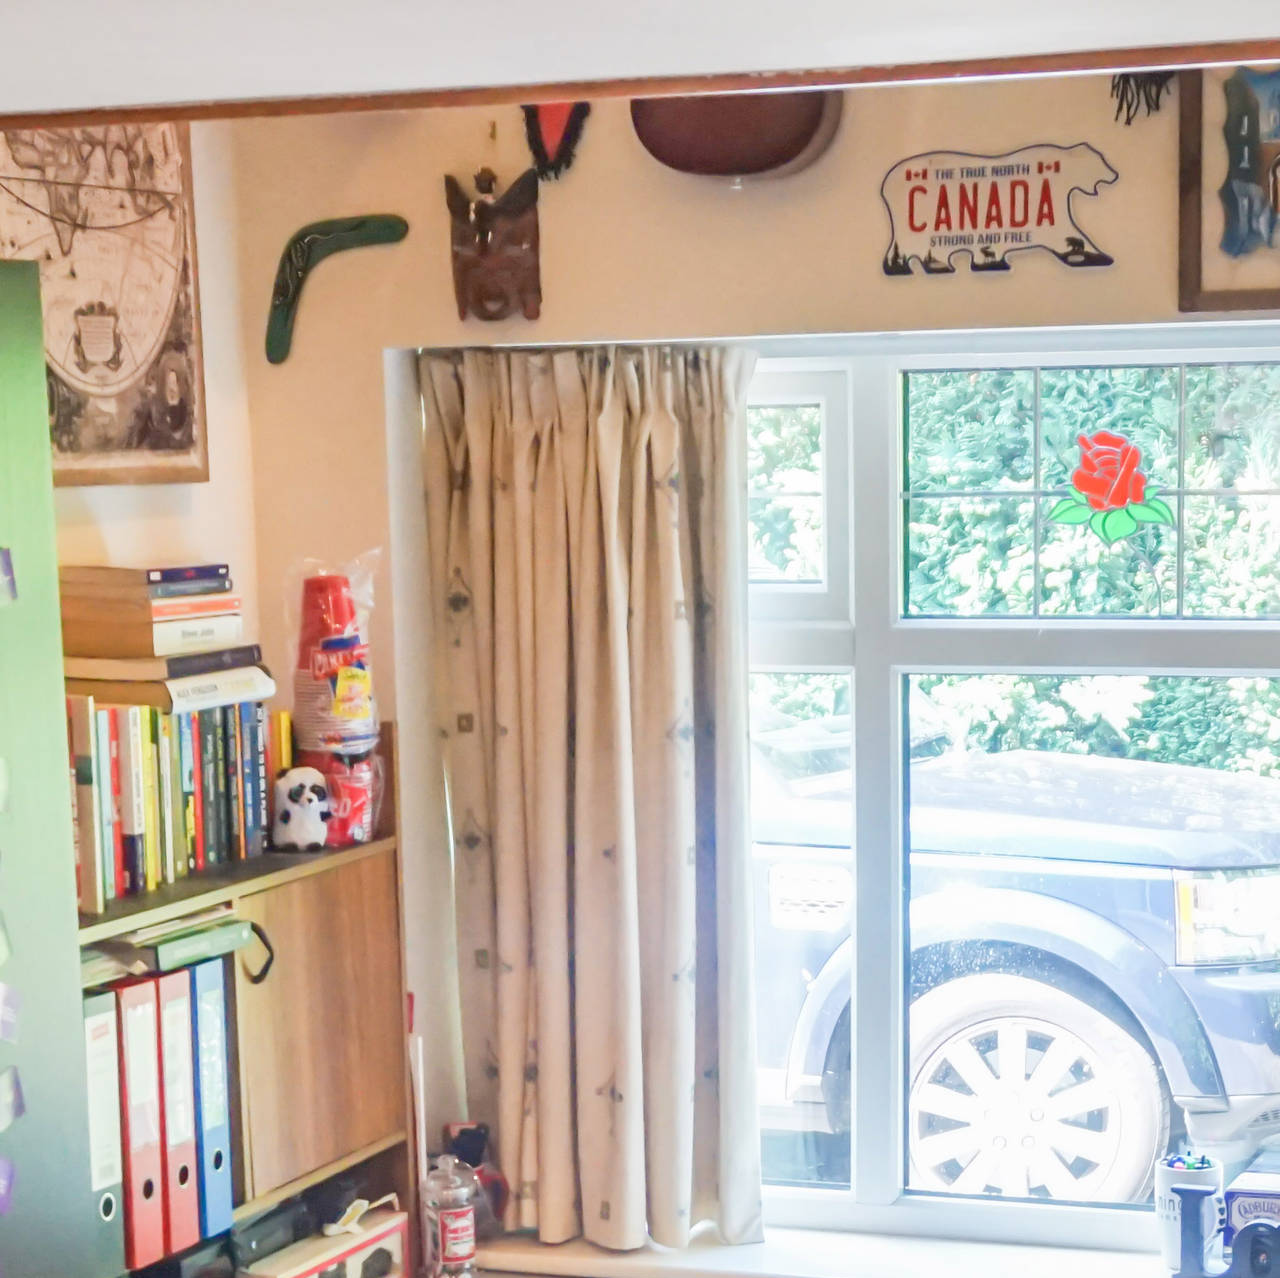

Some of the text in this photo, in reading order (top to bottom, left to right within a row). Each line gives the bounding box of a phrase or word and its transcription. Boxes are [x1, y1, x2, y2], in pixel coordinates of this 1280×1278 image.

[935, 163, 1030, 180] THE TRUE NORTH
[908, 177, 1055, 232] CANADA
[930, 231, 1032, 247] STRONG AND FREE
